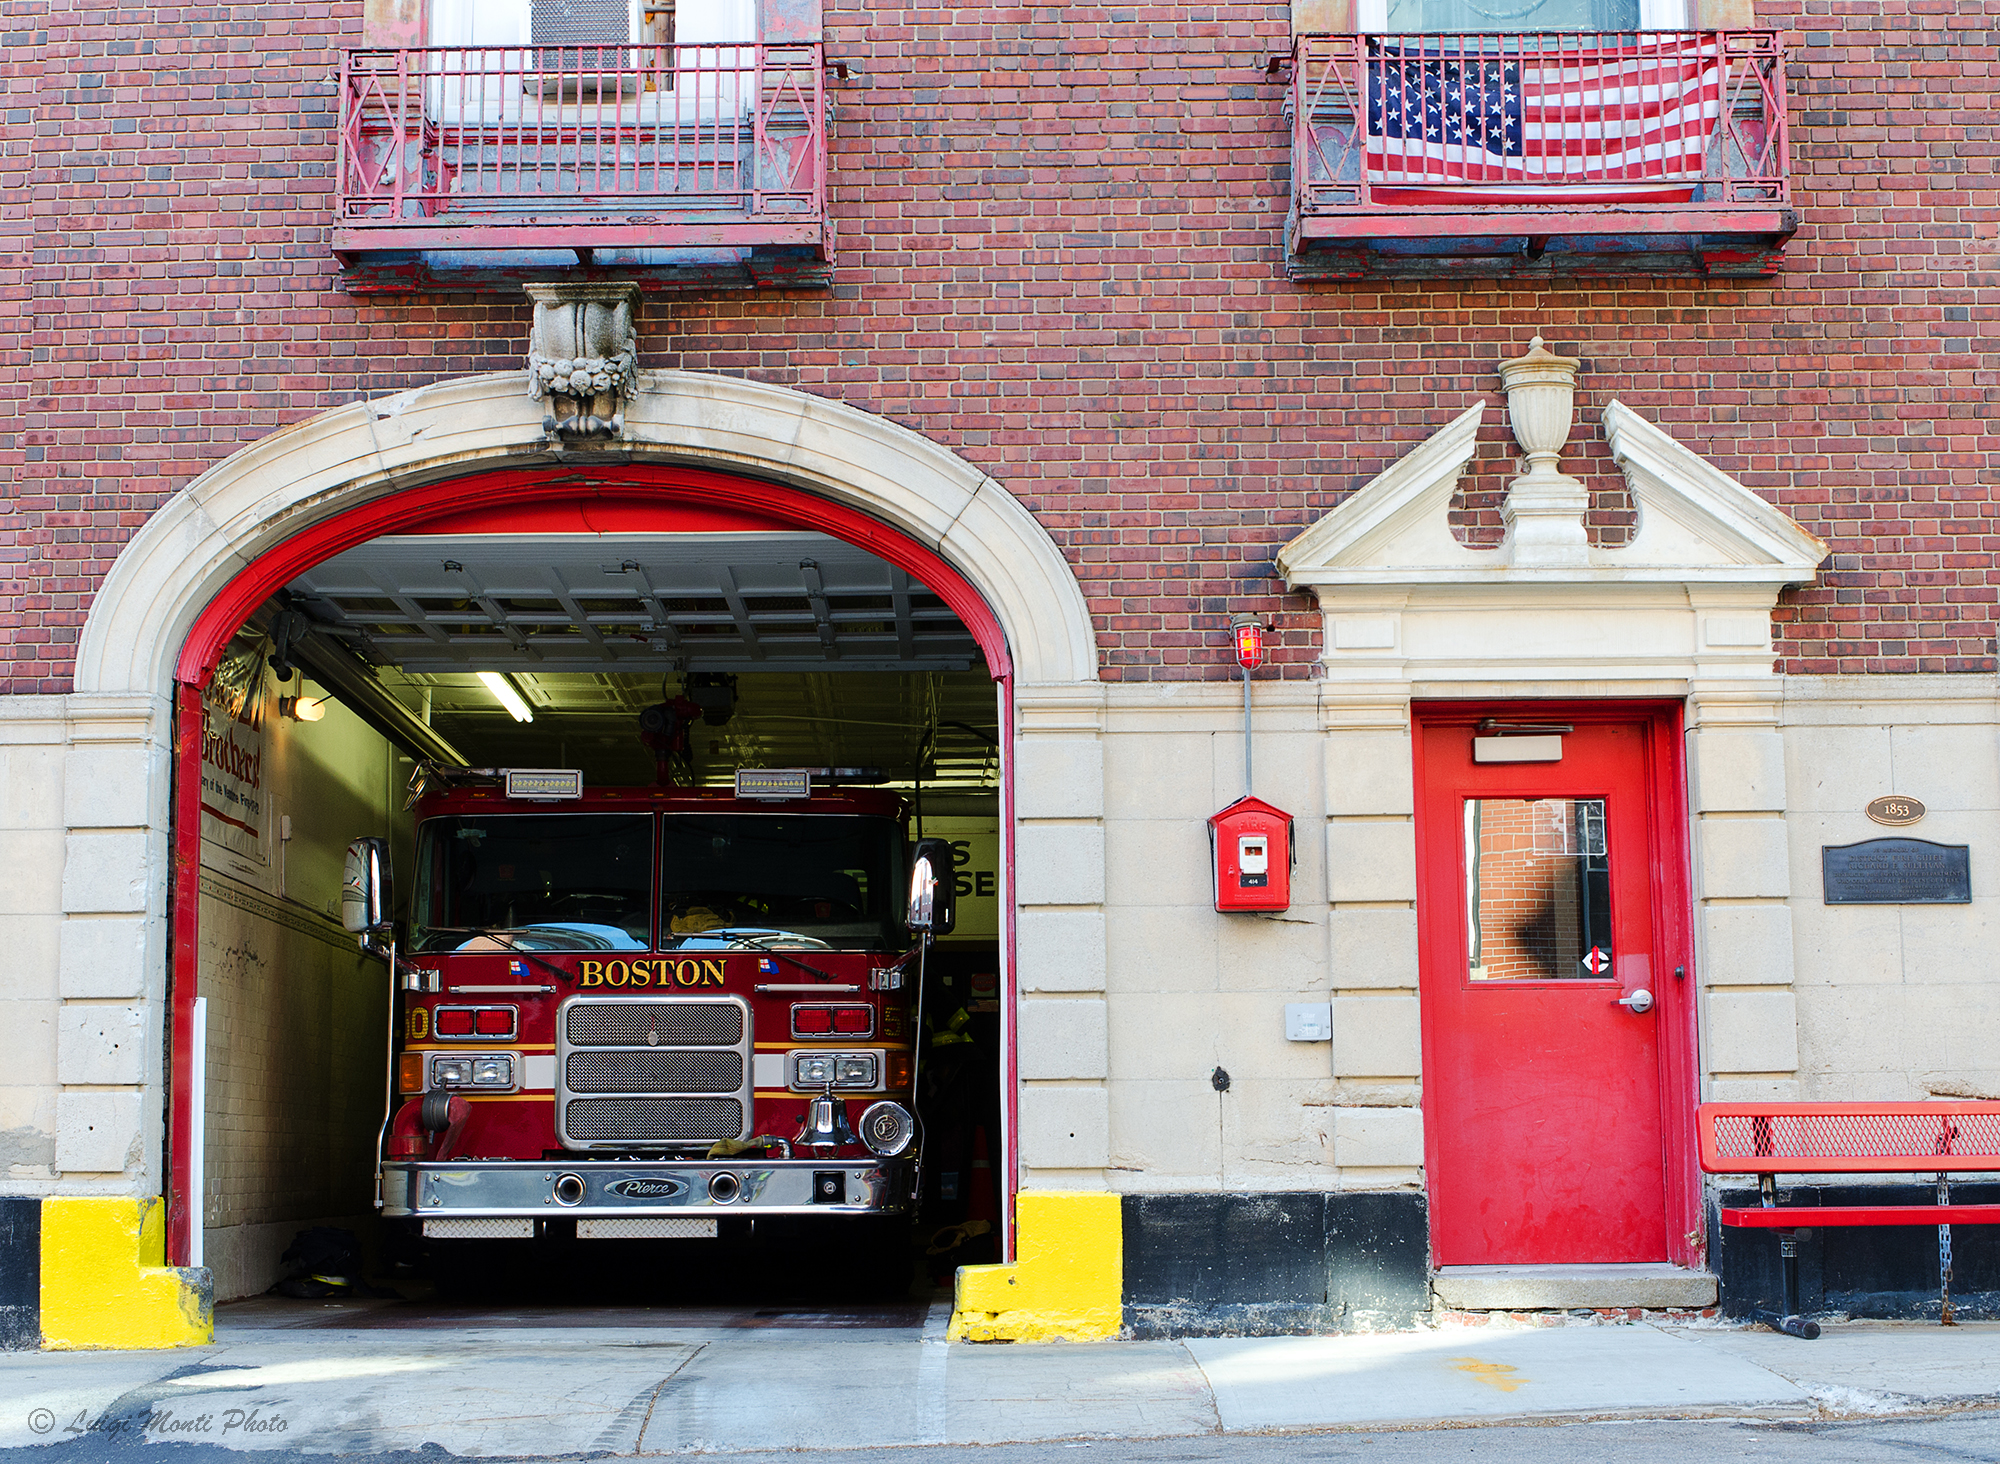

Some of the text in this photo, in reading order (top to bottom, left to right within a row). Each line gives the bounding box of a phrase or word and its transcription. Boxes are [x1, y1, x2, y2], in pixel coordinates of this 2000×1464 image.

[1884, 802, 1910, 817] 1853
[1238, 820, 1267, 831] FIRE
[578, 959, 727, 988] BOSTON
[623, 1180, 670, 1196] Pierce
